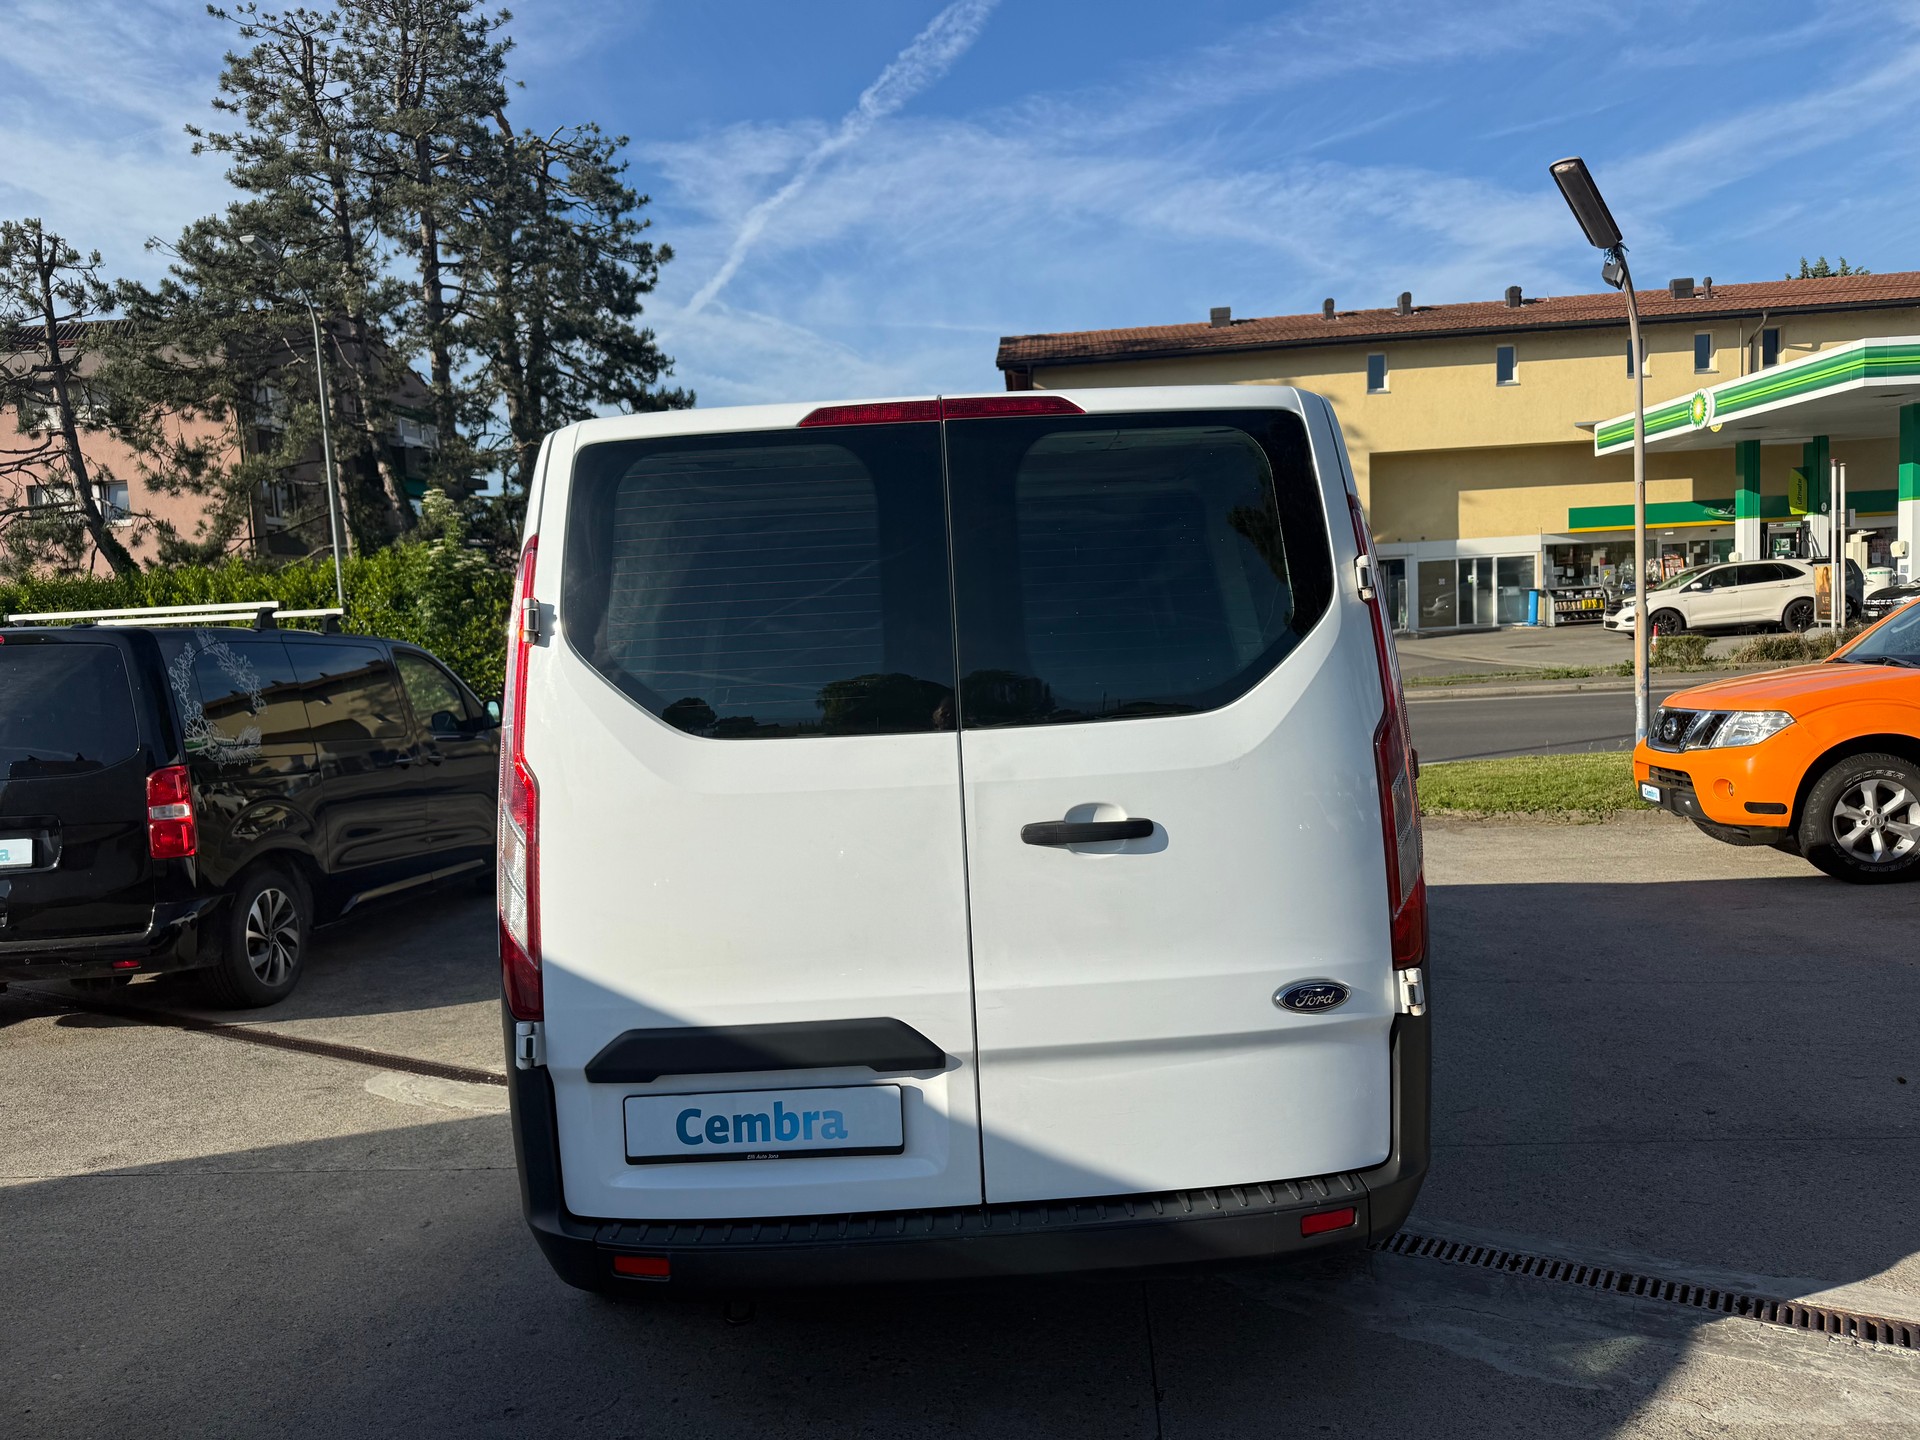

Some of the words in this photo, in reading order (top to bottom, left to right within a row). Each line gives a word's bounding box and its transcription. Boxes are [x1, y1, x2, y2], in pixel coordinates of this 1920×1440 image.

[1844, 769, 1906, 787] COOPER
[1295, 987, 1335, 1007] Ford
[676, 1101, 848, 1145] Cembra
